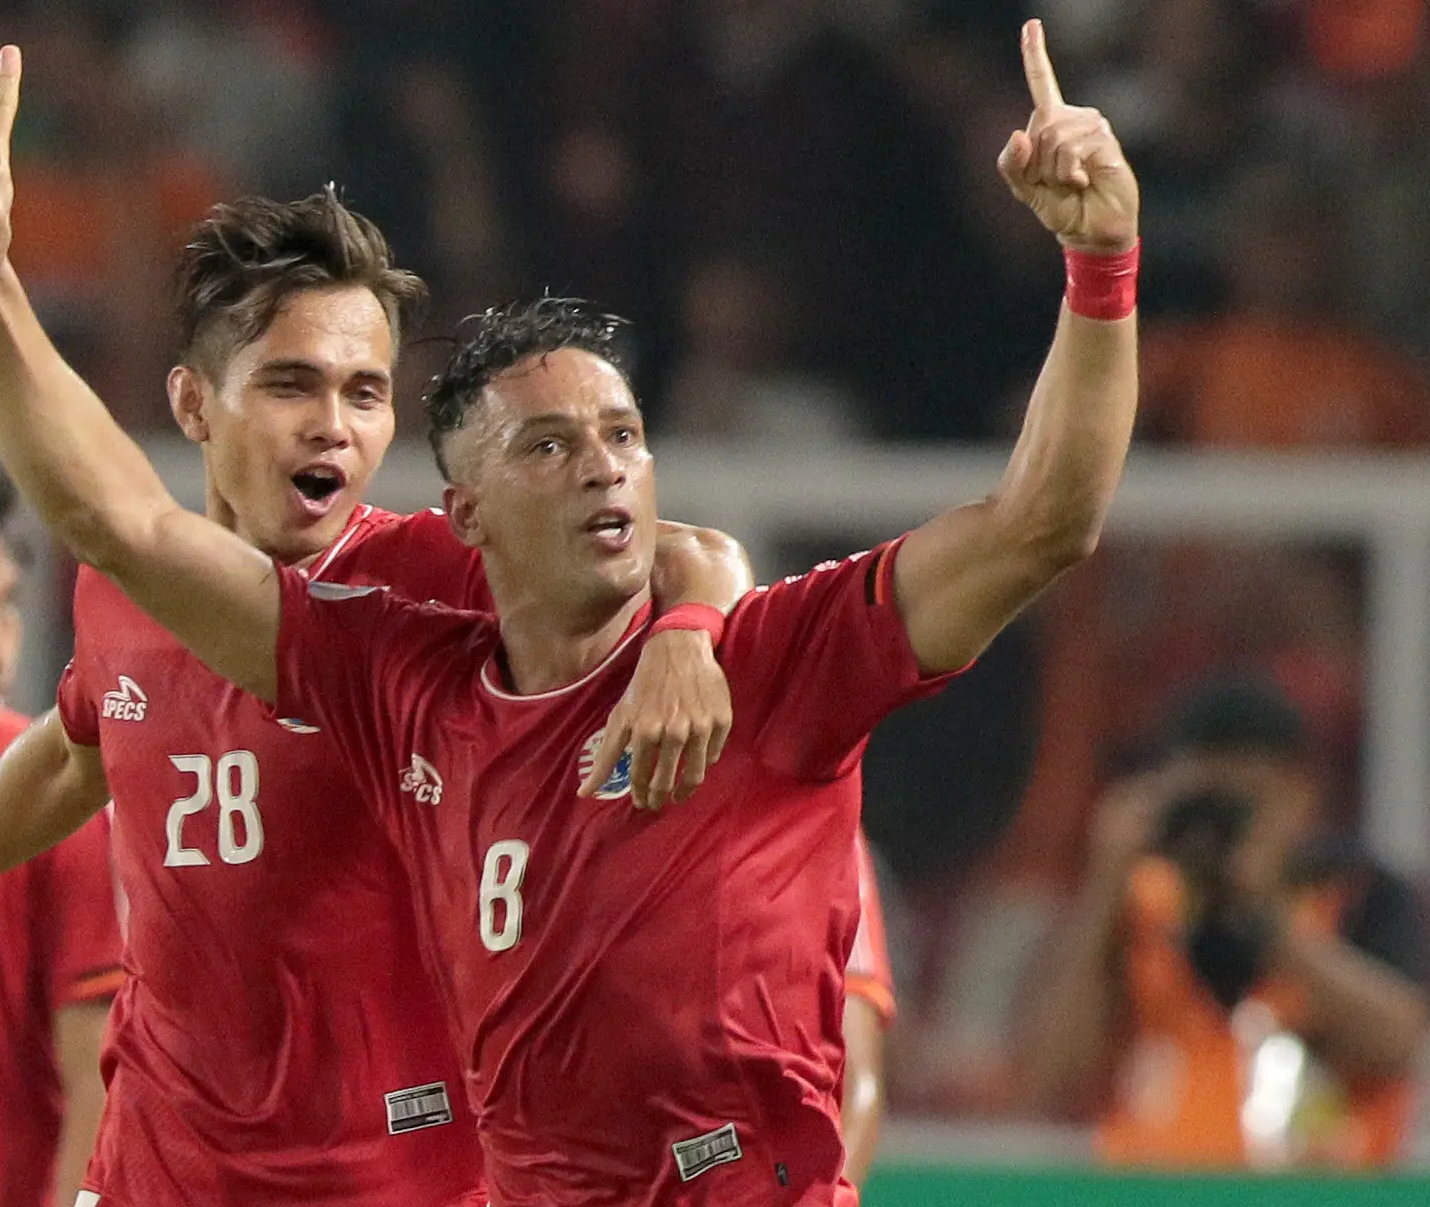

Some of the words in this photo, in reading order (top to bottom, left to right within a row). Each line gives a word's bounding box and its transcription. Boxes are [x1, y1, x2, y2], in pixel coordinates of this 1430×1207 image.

[101, 699, 147, 723] SPECS
[163, 749, 264, 867] 28
[479, 838, 531, 952] 8
